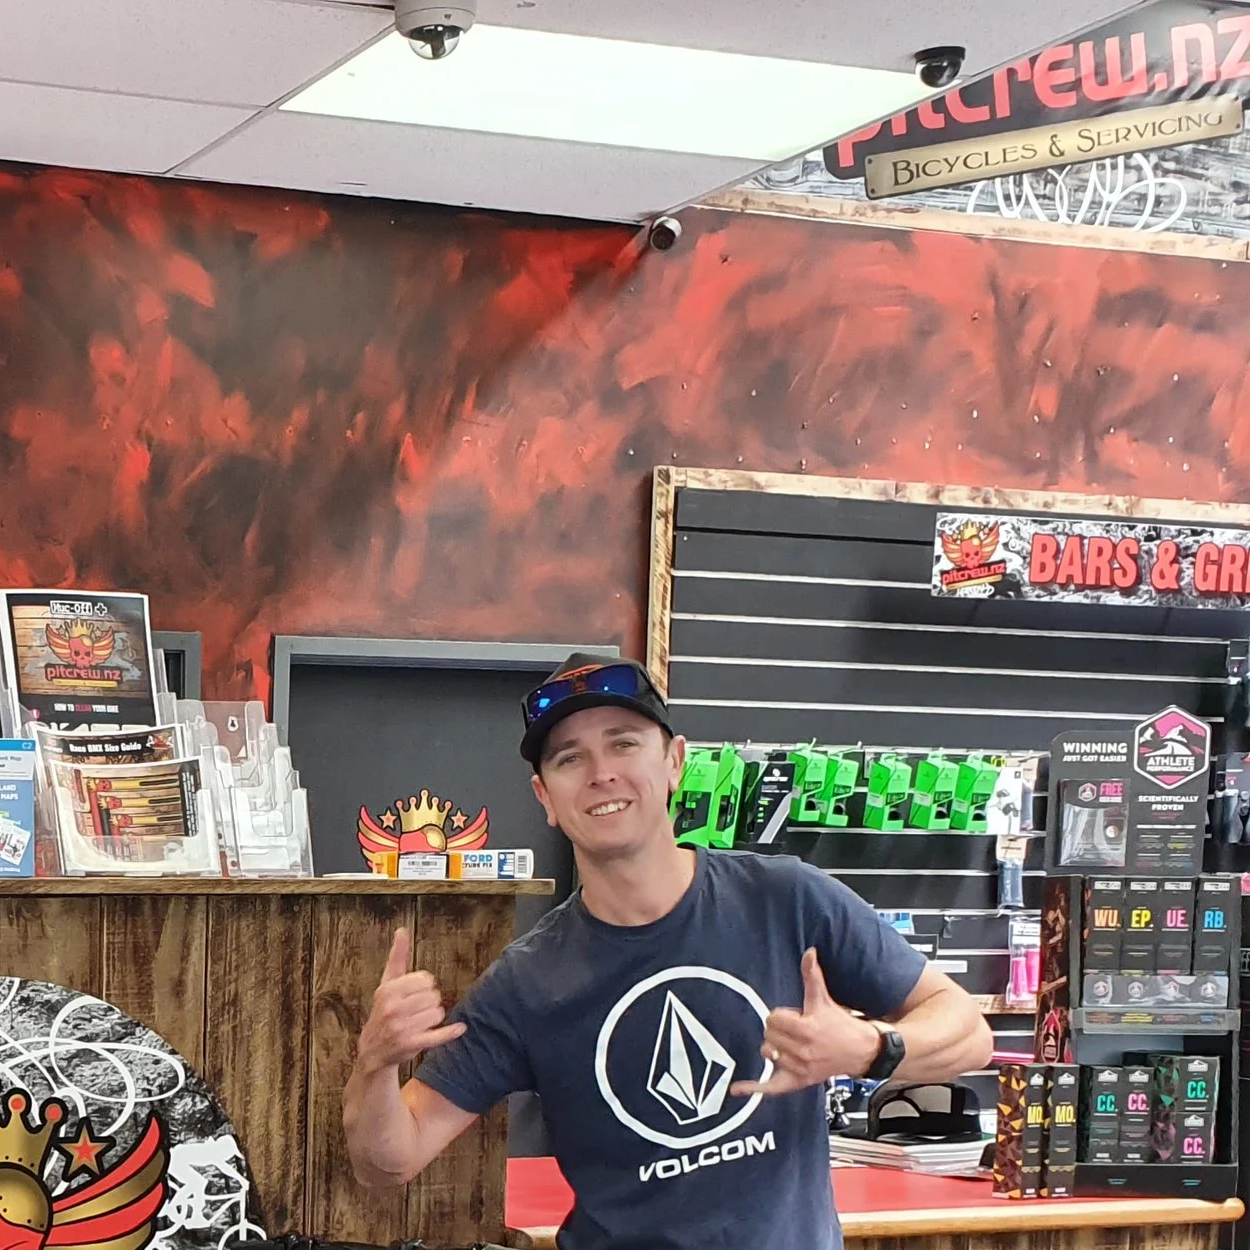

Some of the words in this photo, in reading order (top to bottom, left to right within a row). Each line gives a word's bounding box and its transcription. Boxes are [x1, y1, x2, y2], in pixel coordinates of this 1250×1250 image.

[891, 144, 1038, 187] BICYCLES
[1049, 136, 1065, 158] &
[1077, 112, 1223, 153] SERVICING
[1029, 533, 1139, 589] BARS
[1151, 539, 1180, 591] &
[1194, 543, 1250, 594] GR
[52, 602, 91, 613] Muc-Off
[47, 666, 121, 679] pitcrew.nz
[1063, 743, 1127, 753] WINNING
[1147, 756, 1195, 766] ATHLETE
[639, 1130, 777, 1182] VOLCOM
